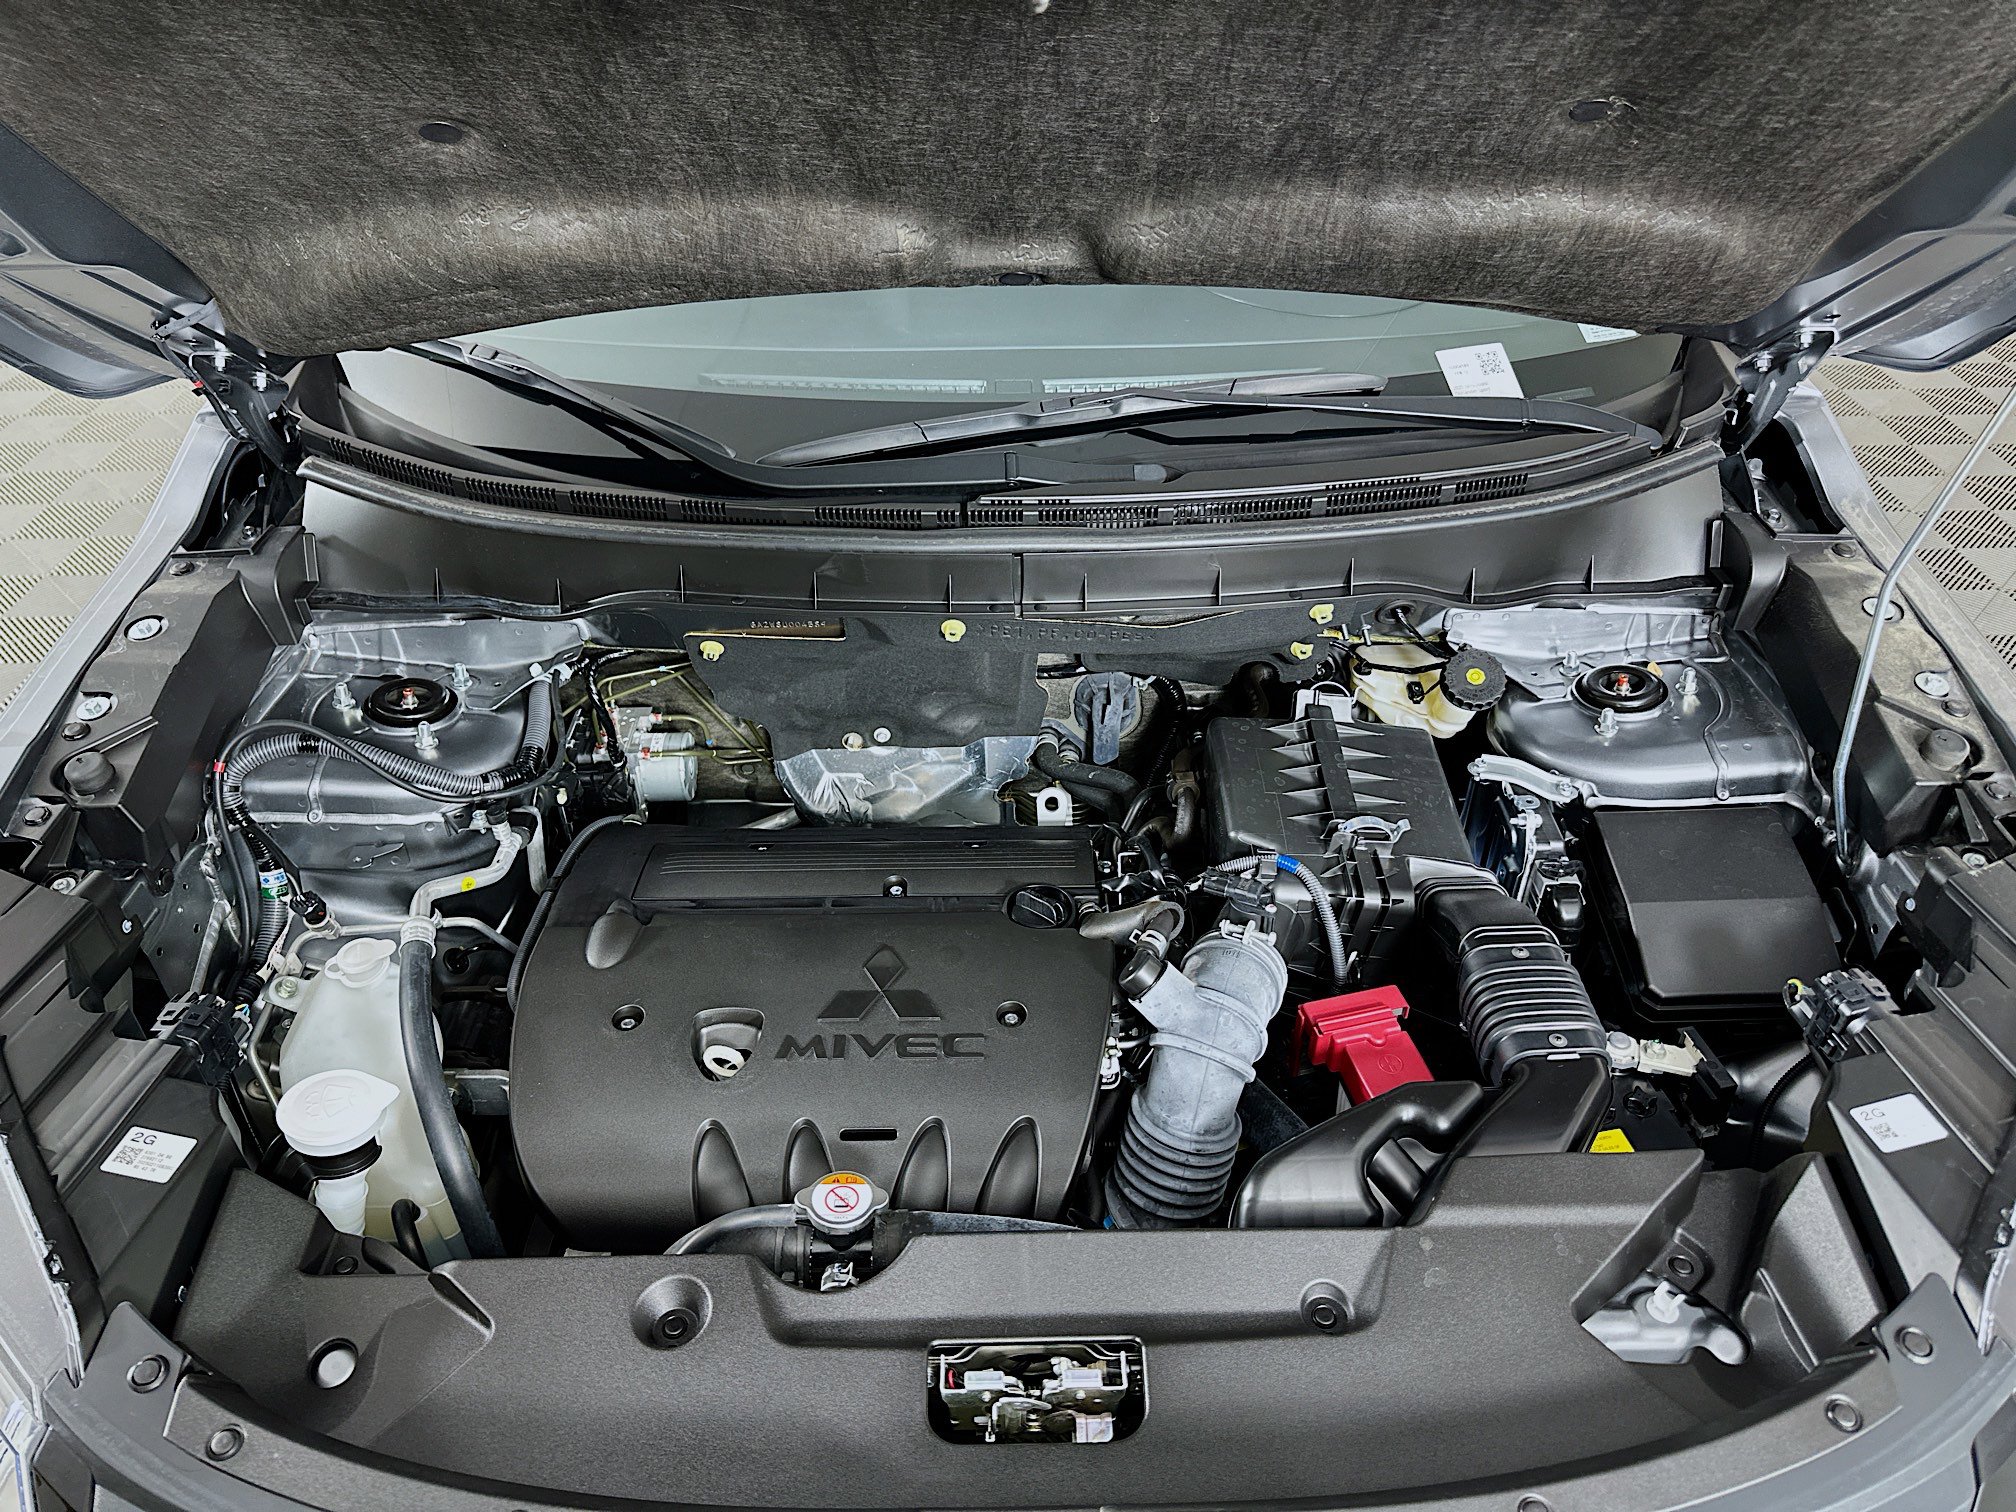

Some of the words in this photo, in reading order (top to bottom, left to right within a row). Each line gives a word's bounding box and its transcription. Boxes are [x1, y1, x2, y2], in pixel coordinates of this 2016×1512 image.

[774, 1033, 986, 1060] MIVEC
[1860, 1108, 1886, 1121] 2G
[130, 1132, 158, 1145] 2G
